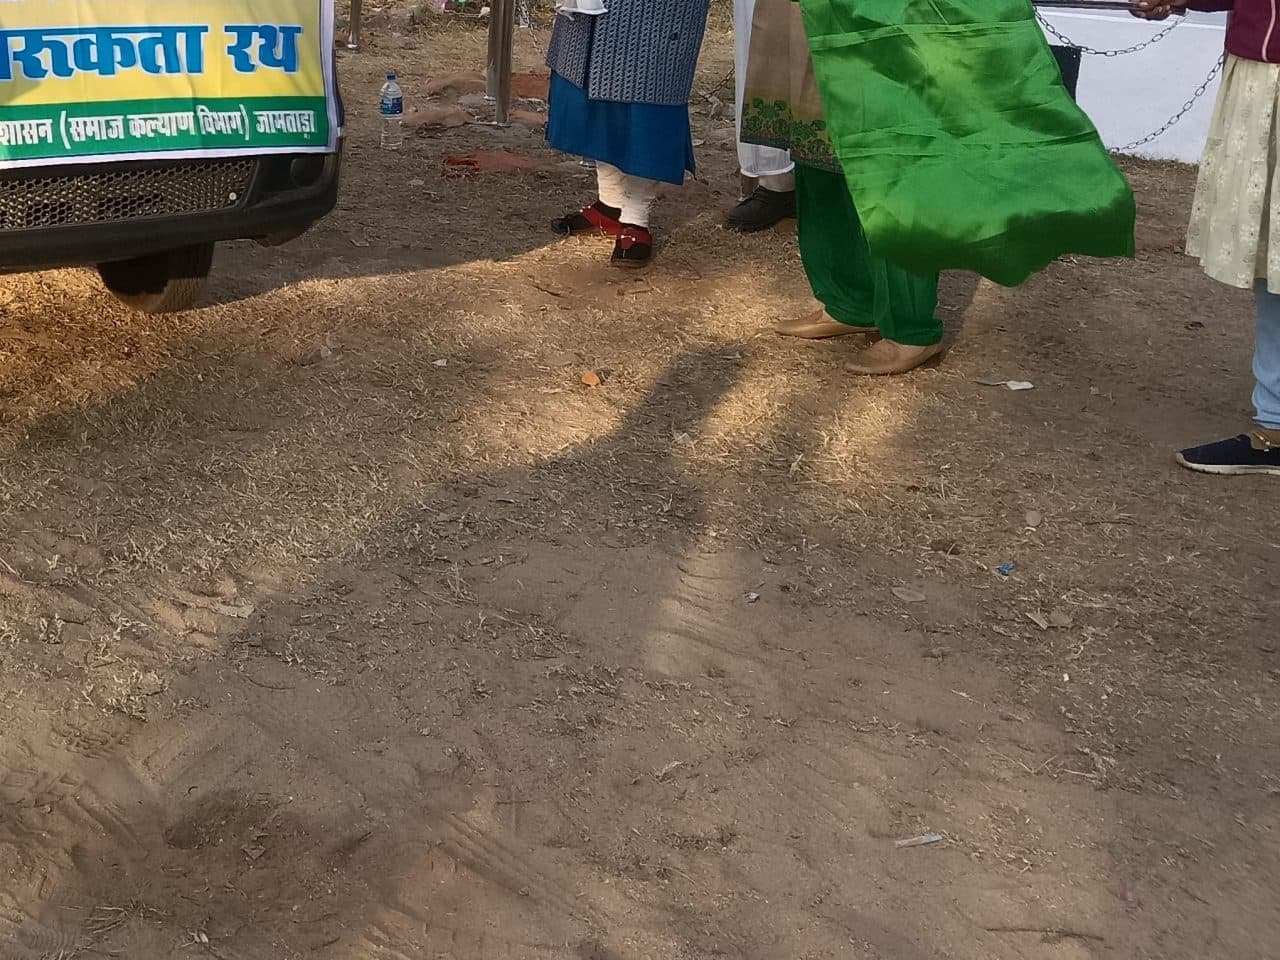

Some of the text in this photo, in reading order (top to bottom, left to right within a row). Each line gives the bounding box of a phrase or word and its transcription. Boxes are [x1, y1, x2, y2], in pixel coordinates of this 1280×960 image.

[224, 25, 302, 72] रथ
[60, 110, 125, 150] (समाज
[126, 112, 196, 139] कल्याण
[196, 104, 250, 140] विभाग)
[253, 110, 317, 139] जामताड़ा
